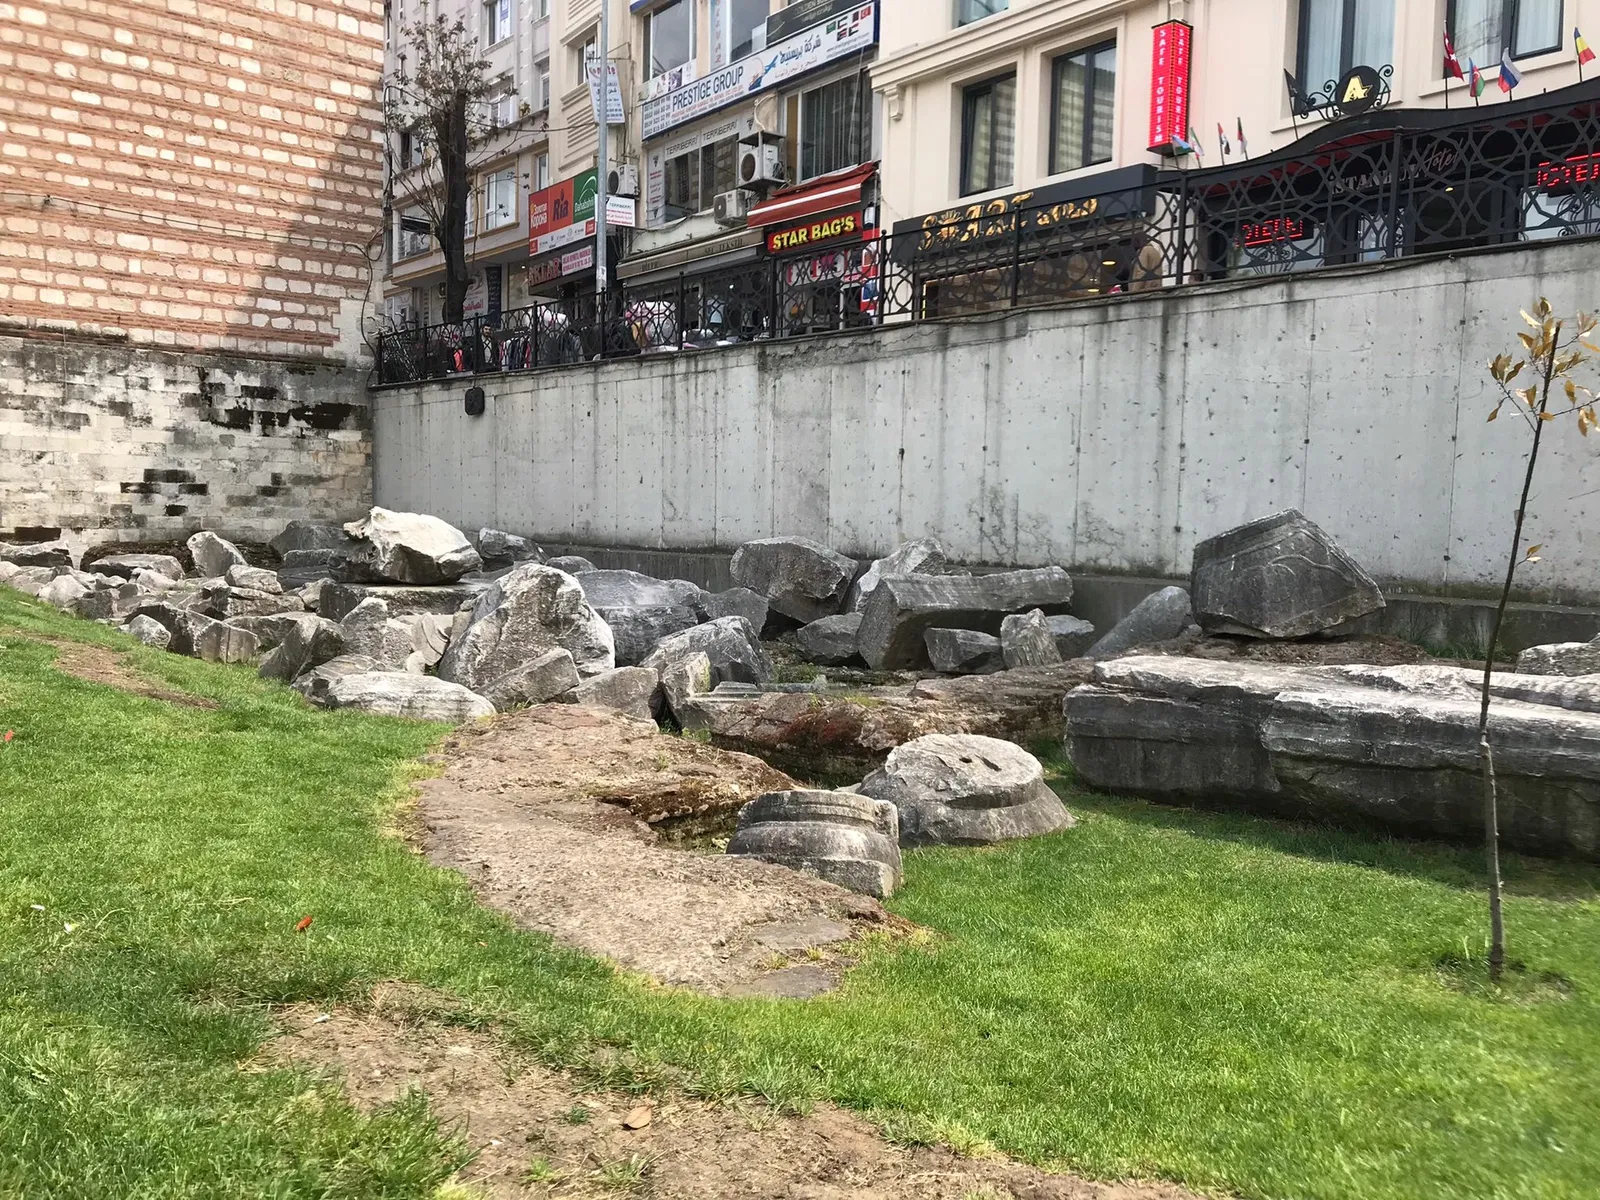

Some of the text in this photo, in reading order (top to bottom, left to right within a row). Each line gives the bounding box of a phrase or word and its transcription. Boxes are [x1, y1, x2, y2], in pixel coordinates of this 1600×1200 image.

[713, 66, 744, 94] GROUP
[1154, 76, 1165, 142] TOURISM
[553, 193, 569, 221] Ria
[772, 215, 855, 250] STAR BAG'S
